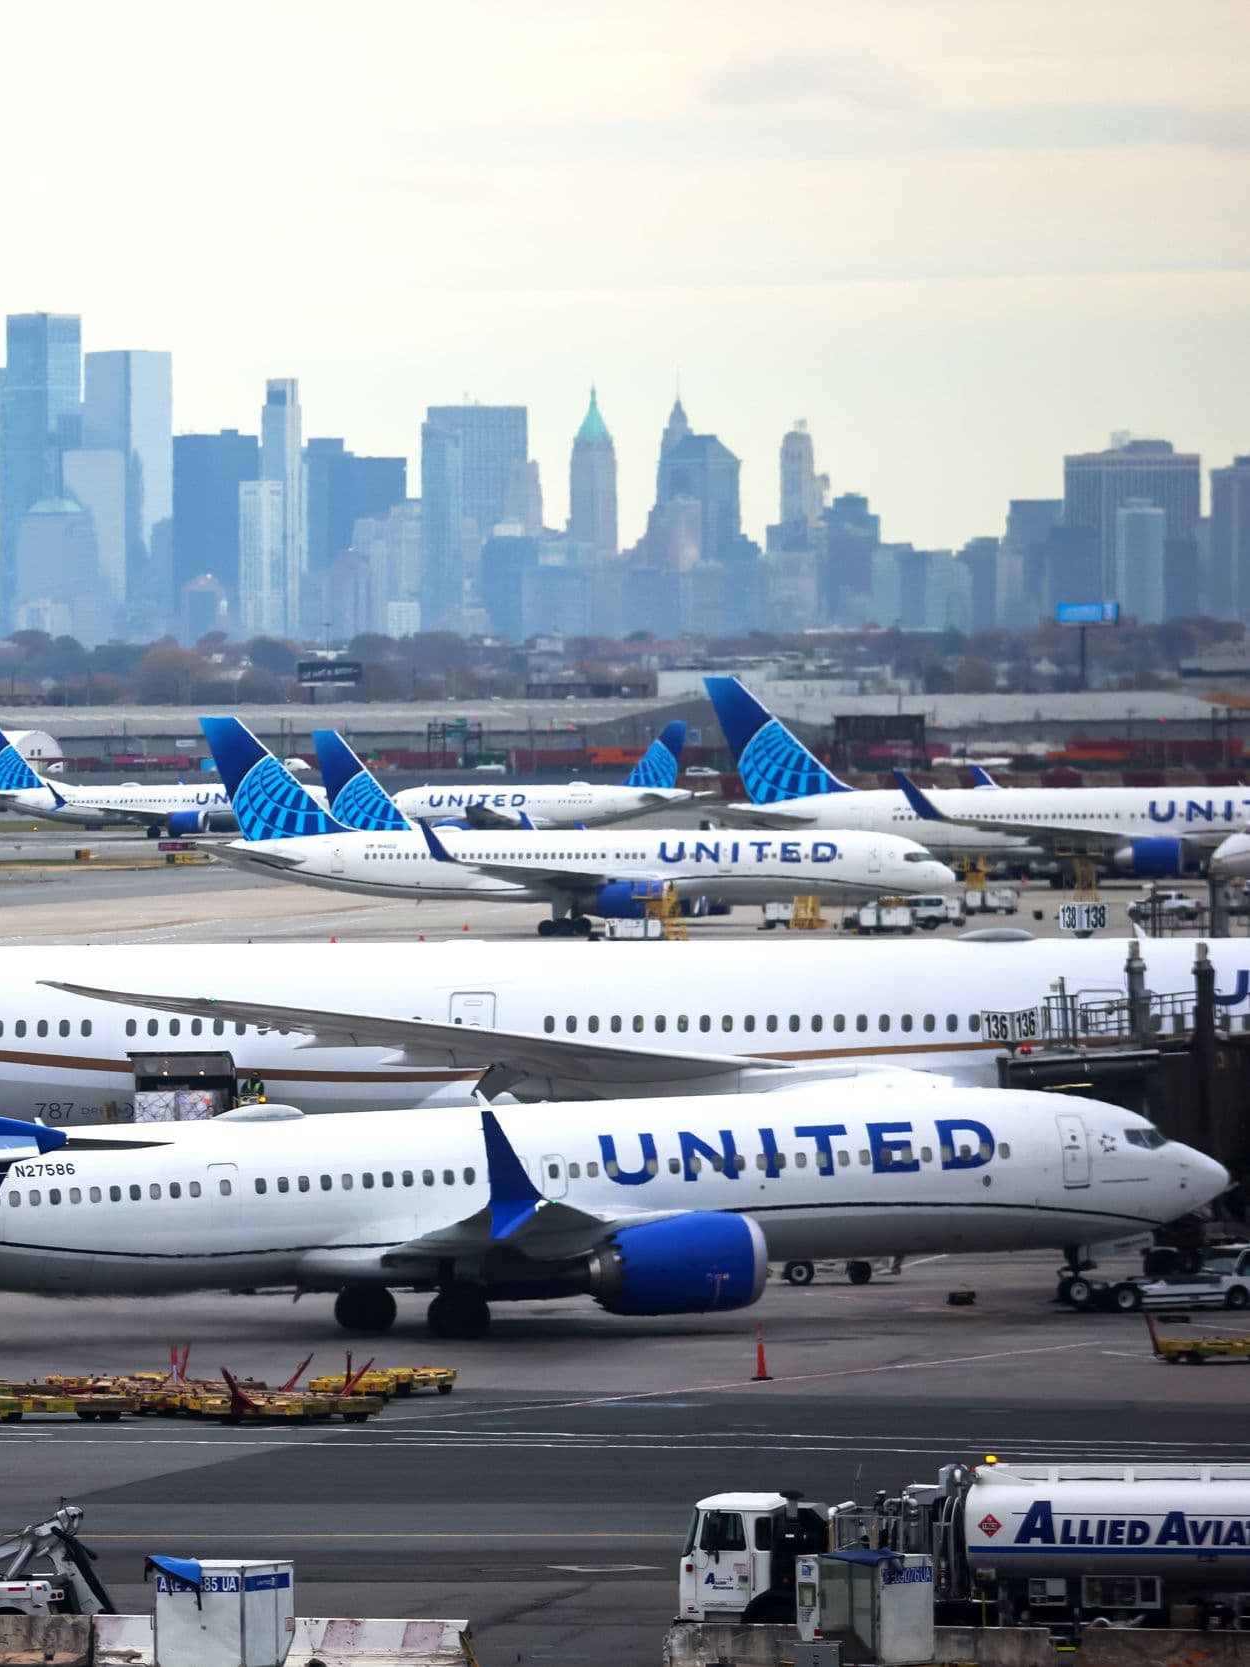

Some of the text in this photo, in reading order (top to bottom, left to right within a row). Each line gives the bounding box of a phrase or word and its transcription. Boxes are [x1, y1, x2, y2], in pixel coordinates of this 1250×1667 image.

[428, 793, 526, 808] UNITED
[1149, 800, 1250, 822] UNI
[659, 841, 839, 863] UNITED
[1061, 905, 1077, 929] 138
[1084, 905, 1106, 929] 138
[985, 1013, 1008, 1040] 136
[1016, 1011, 1036, 1037] 136
[34, 1102, 75, 1120] 787
[598, 1118, 995, 1186] UNITED
[14, 1162, 76, 1178] N27586
[1013, 1500, 1250, 1546] ALLIED AVIA
[222, 1576, 237, 1592] UA
